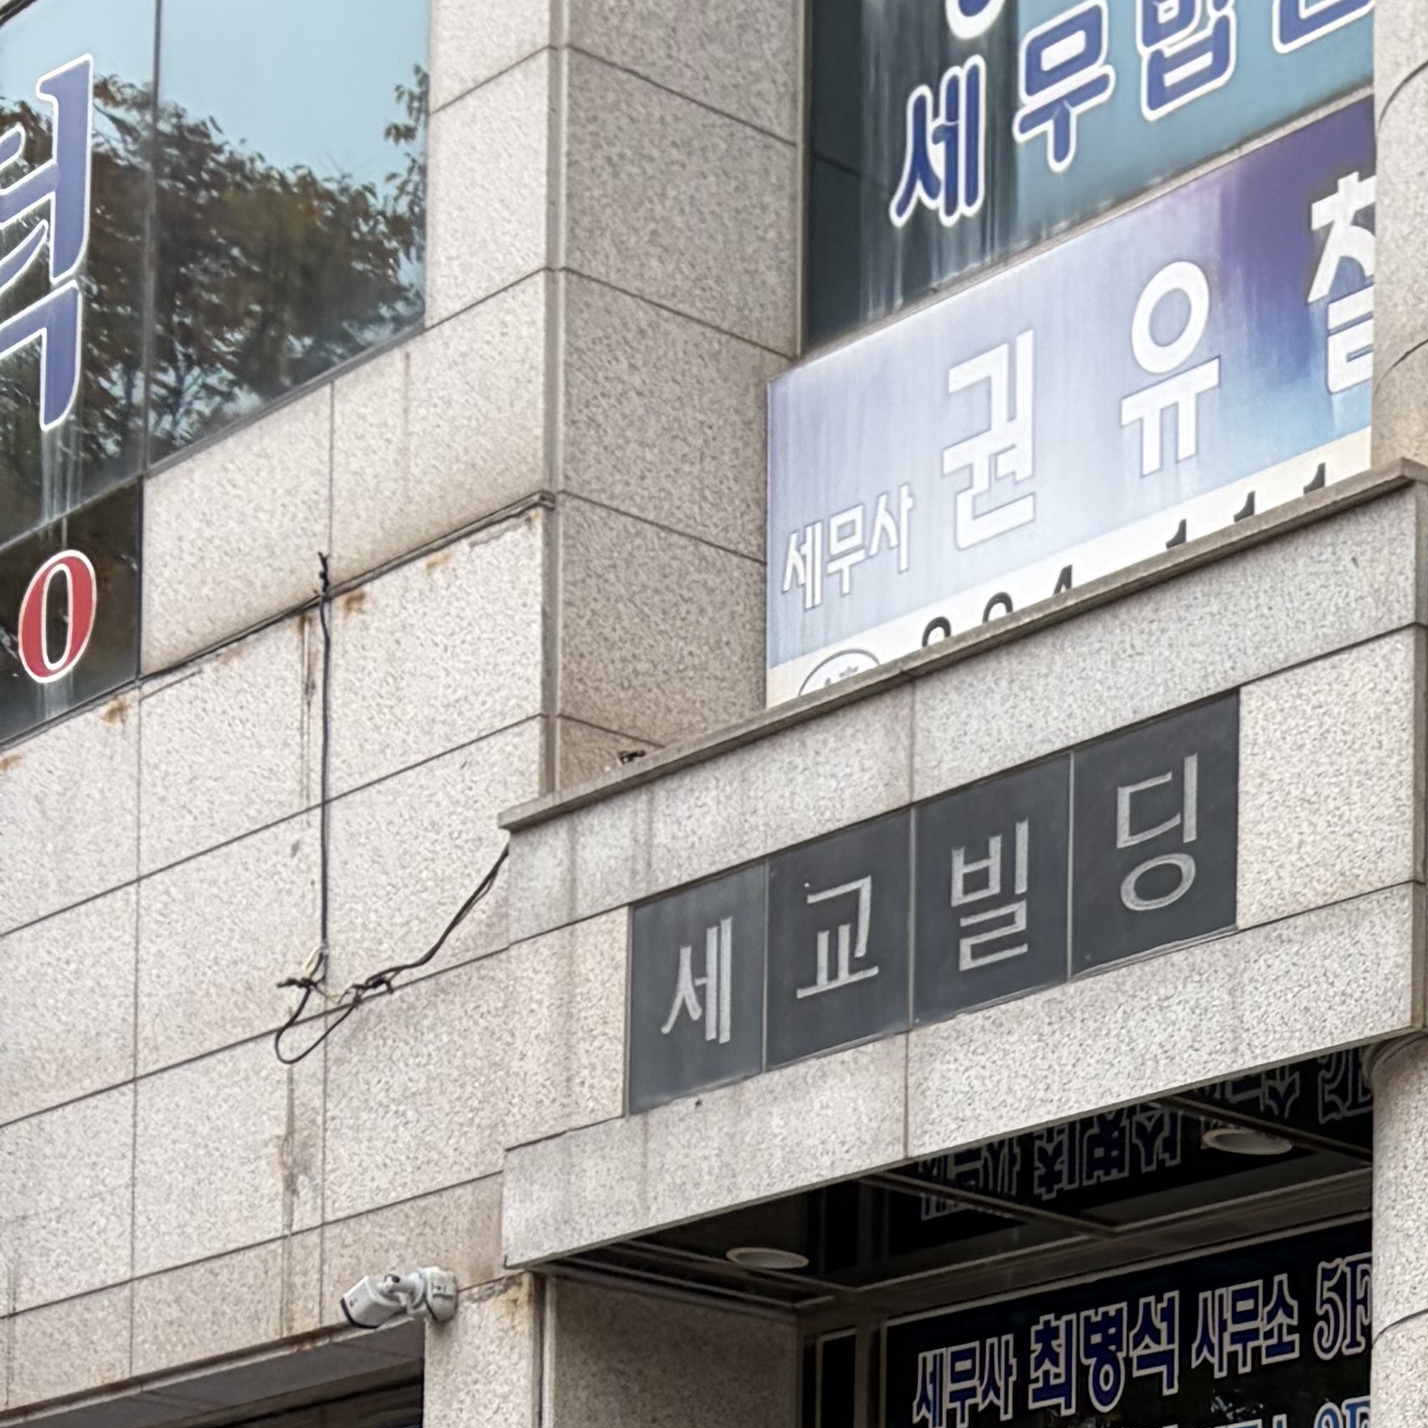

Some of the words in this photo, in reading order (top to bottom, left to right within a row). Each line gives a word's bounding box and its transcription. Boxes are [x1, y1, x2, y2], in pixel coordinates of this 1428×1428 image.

[890, 0, 1374, 227] 세무법
[781, 481, 914, 611] 세무사
[661, 753, 1198, 1046] 세교빌딩
[1028, 1291, 1179, 1416] 최병석
[1191, 1258, 1300, 1379] 사무소
[1313, 1251, 1372, 1361] 5F
